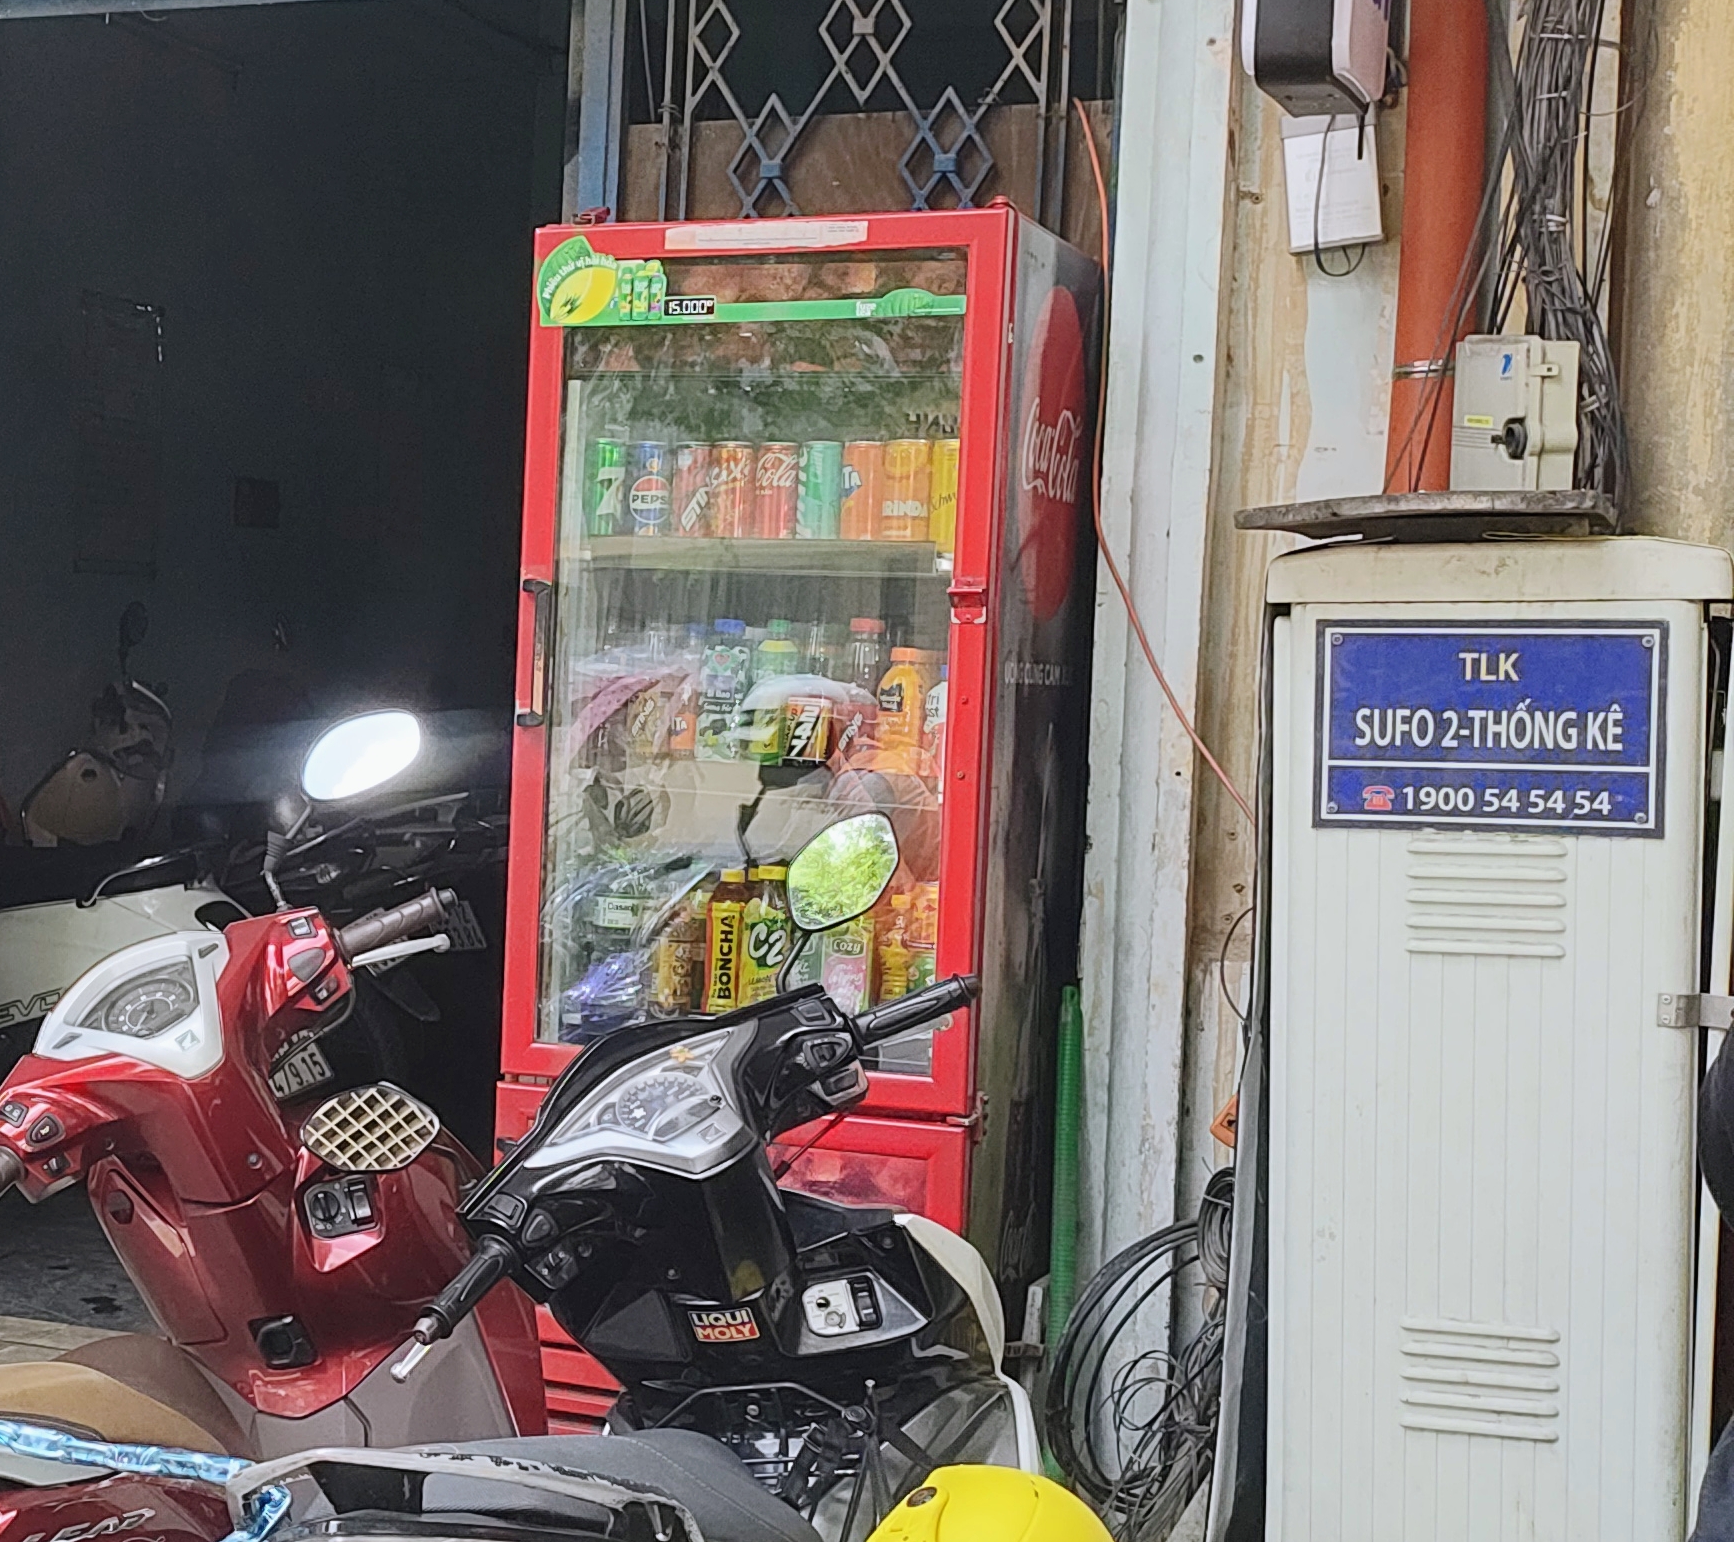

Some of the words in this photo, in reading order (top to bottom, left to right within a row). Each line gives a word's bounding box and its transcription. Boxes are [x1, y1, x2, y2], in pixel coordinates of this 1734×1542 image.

[1458, 651, 1520, 682] TLK
[1355, 707, 1435, 748] SUFO
[1441, 697, 1579, 751] 2-THỐNG
[1586, 703, 1624, 752] KÊ
[1402, 785, 1475, 812] 1900
[1482, 787, 1520, 814] 54
[1528, 788, 1566, 815] 54
[1573, 789, 1612, 816] 54
[717, 914, 736, 1001] BONCHA
[748, 922, 787, 969] C2
[833, 938, 862, 955] Cozy
[691, 1308, 753, 1327] LIQUI
[695, 1323, 755, 1342] MOLY
